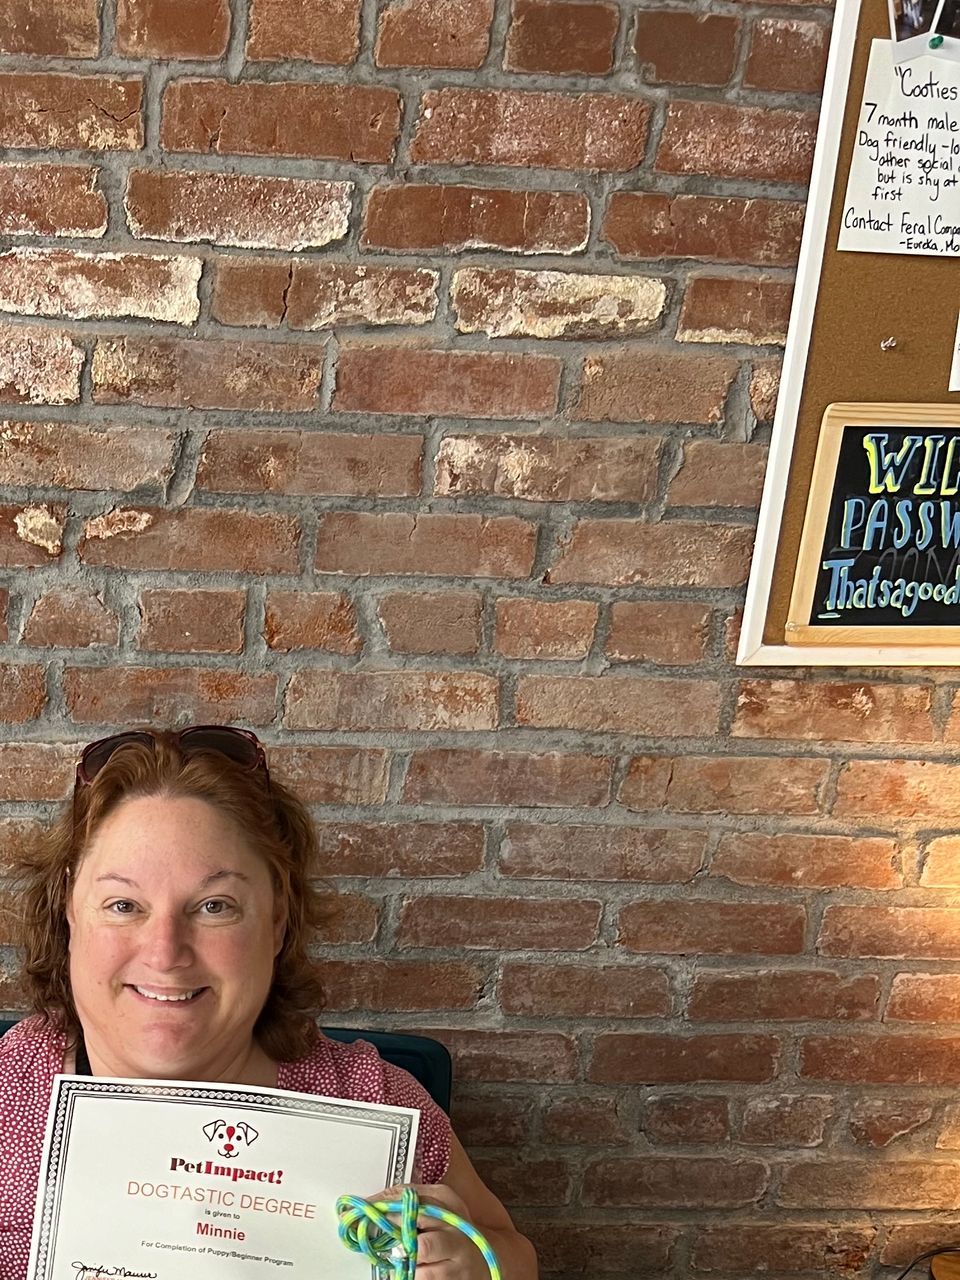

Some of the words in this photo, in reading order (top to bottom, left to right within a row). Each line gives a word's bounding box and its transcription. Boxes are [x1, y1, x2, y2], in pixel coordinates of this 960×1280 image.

[865, 102, 877, 123] 7
[878, 110, 918, 129] month
[928, 112, 959, 131] male
[859, 131, 879, 161] Dog
[884, 131, 936, 164] friendly
[879, 151, 910, 168] other
[918, 157, 952, 171] social
[871, 186, 903, 201] first
[878, 168, 896, 184] but
[902, 172, 913, 184] is
[918, 173, 939, 201] shy
[944, 174, 958, 187] at
[844, 207, 893, 231] Contact
[901, 212, 931, 235] Feral
[169, 1157, 284, 1185] PetImpact!
[127, 1181, 235, 1206] DOGTASTIC
[240, 1194, 317, 1219] DEGREE
[213, 1210, 232, 1219] given
[196, 1222, 246, 1241] Minnie
[141, 1240, 154, 1248] For
[155, 1242, 197, 1253] Completion
[264, 1256, 294, 1267] Program
